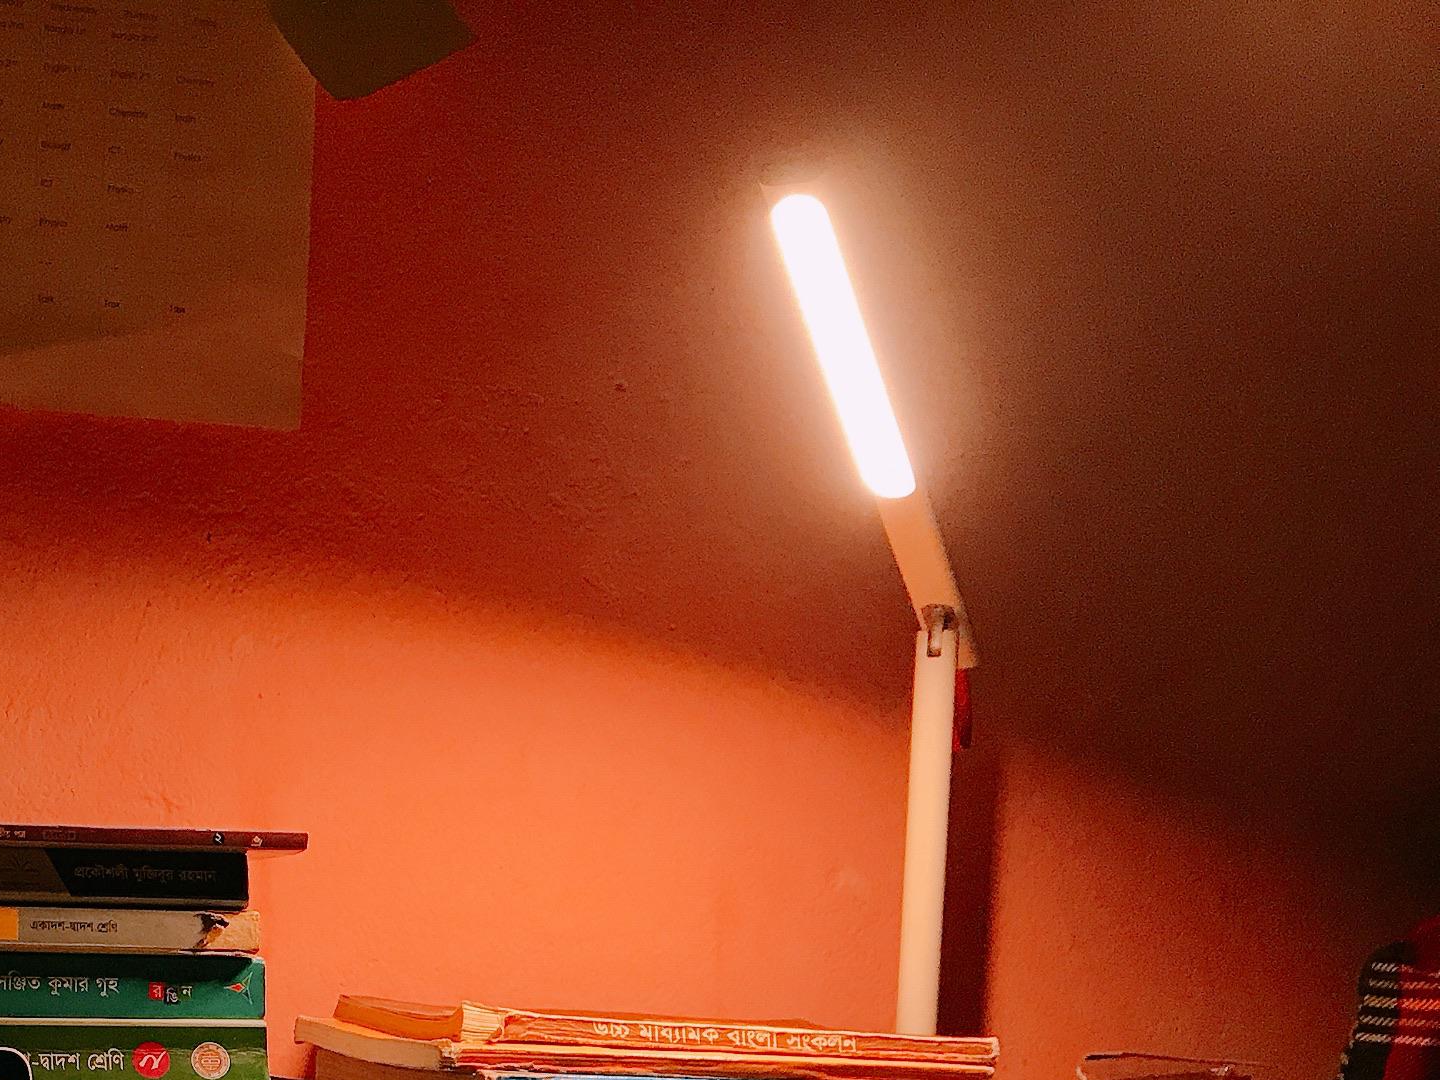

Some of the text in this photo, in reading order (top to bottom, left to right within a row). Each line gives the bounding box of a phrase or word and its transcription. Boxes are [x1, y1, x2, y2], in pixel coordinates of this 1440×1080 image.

[30, 919, 119, 933] একাদশ-দ্বাদশ শ্রেণি
[48, 977, 89, 996] কুমার
[95, 977, 121, 998] গুহ
[87, 1047, 125, 1072] শ্রেণি
